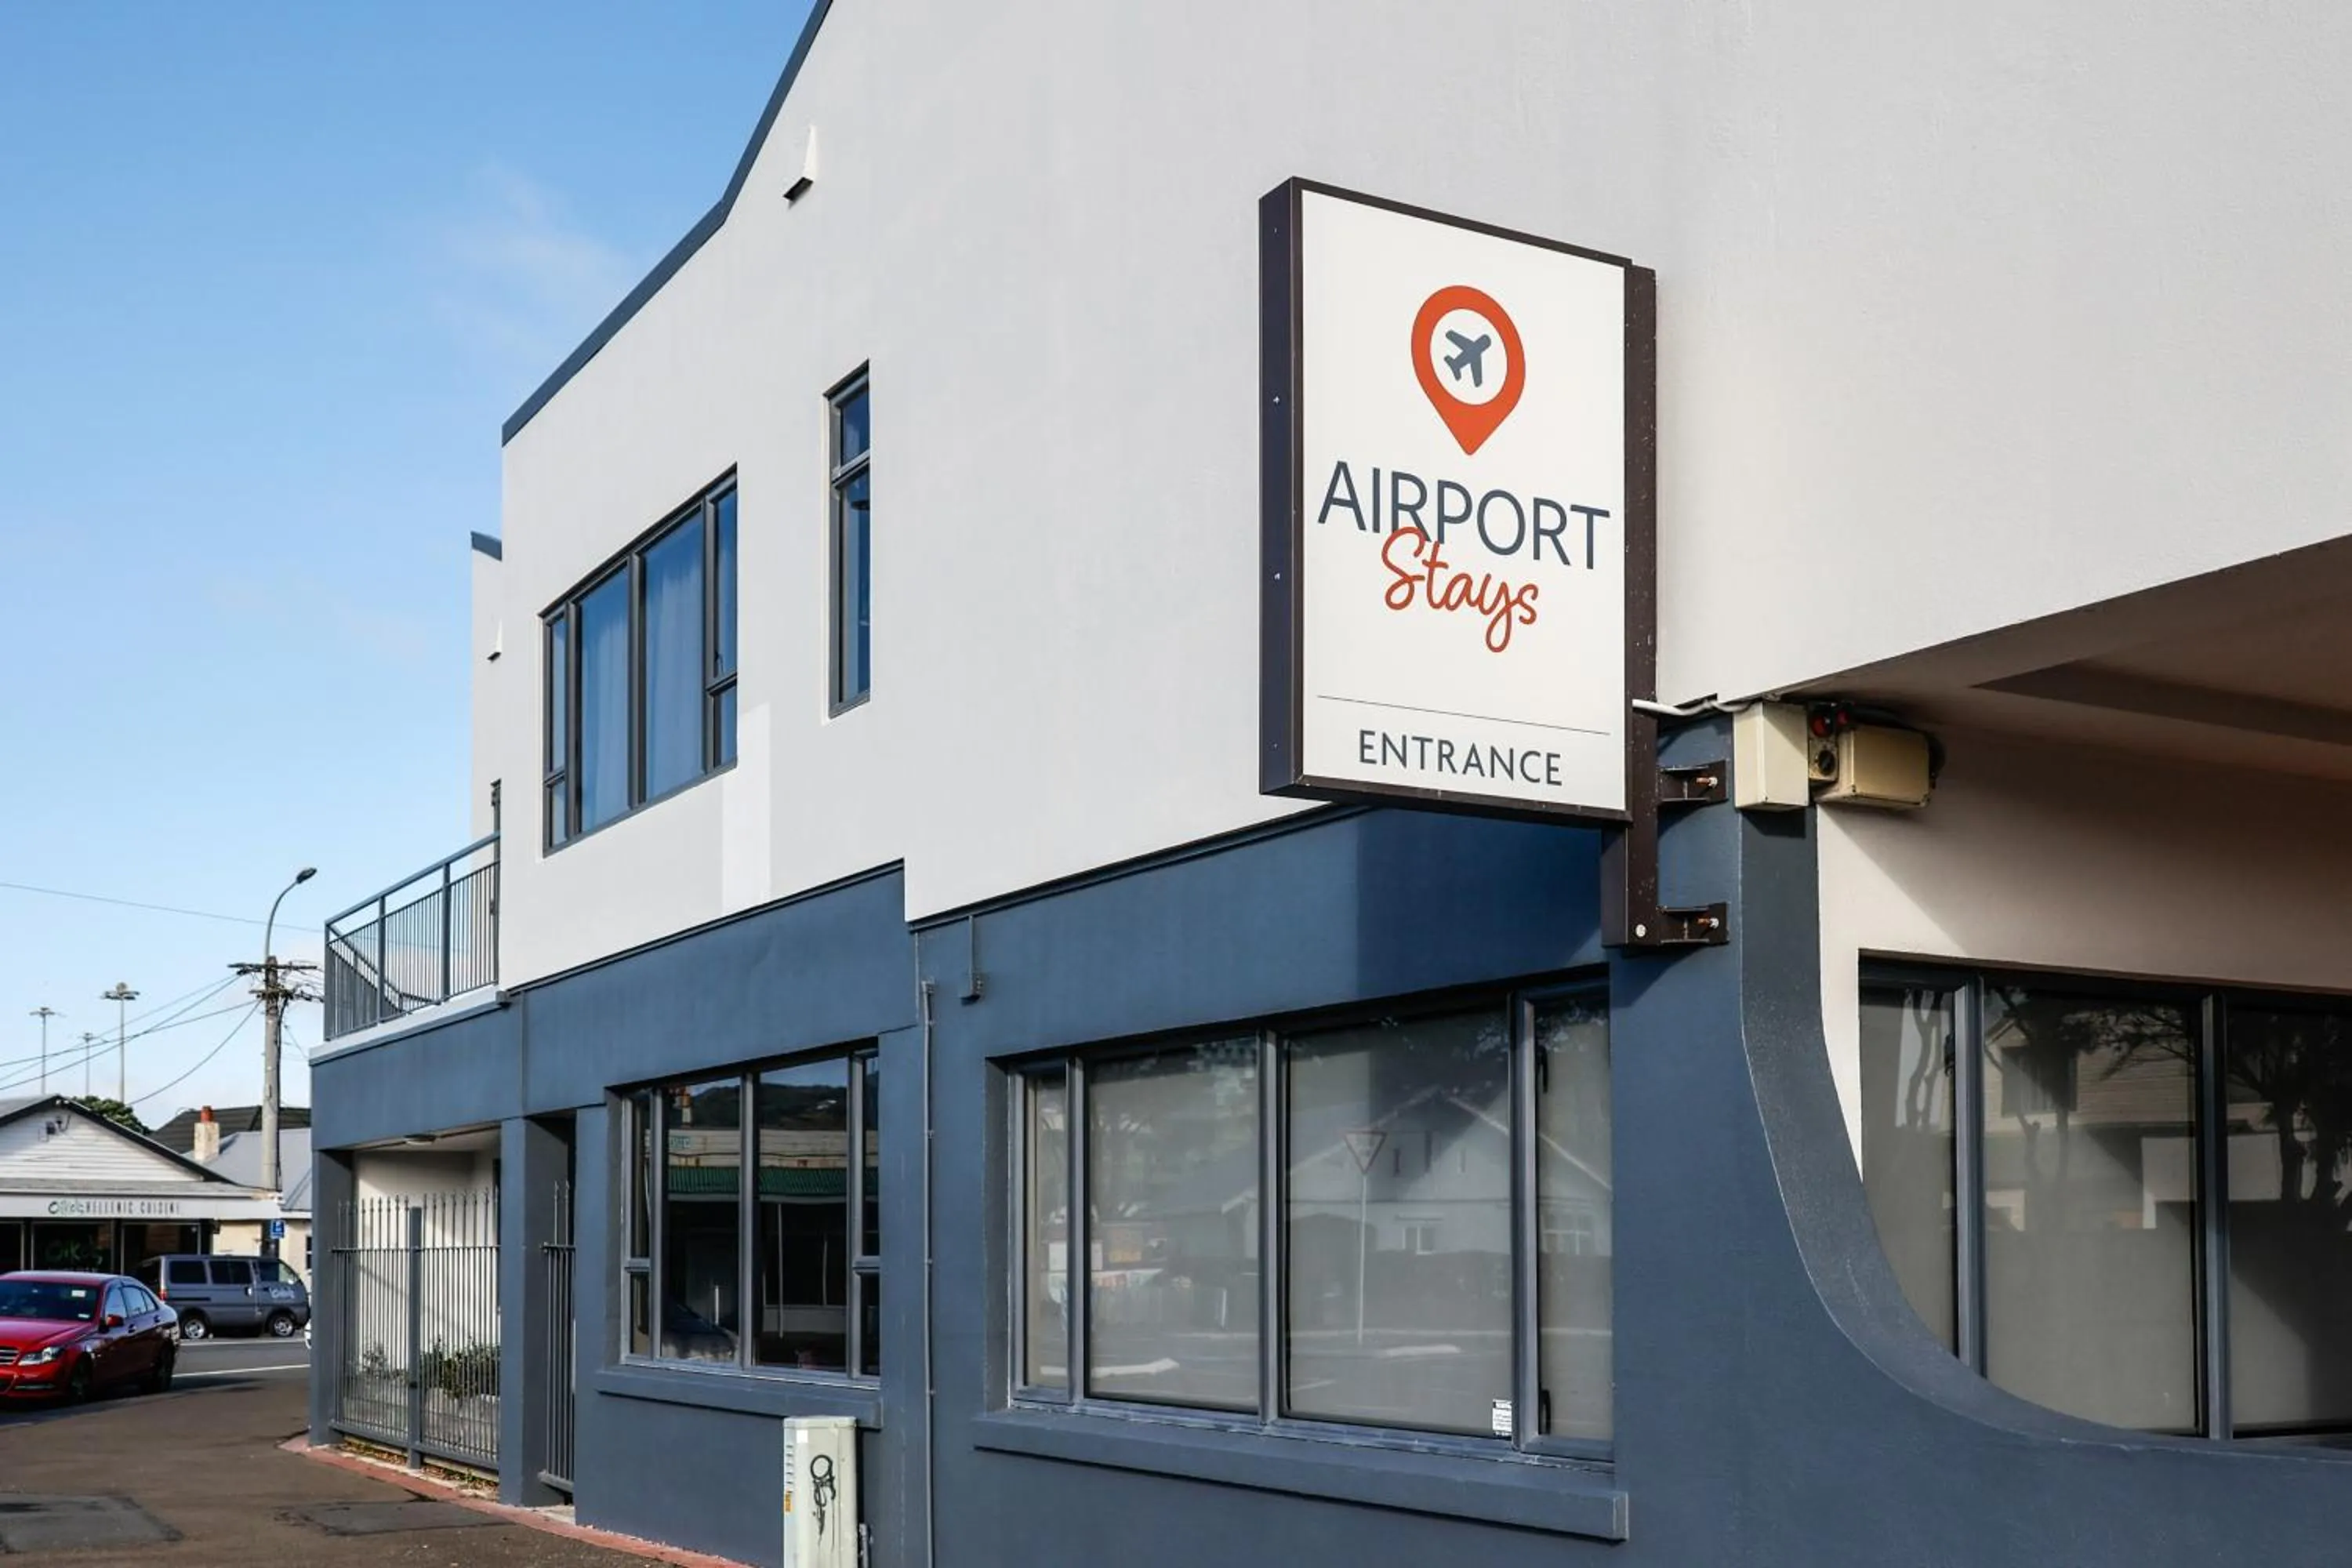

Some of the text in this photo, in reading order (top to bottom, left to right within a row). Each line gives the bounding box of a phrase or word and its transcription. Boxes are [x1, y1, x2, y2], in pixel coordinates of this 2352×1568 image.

[1317, 460, 1610, 570] AIRPORT
[1381, 526, 1539, 653] Stays
[1358, 729, 1563, 786] ENTRANCE
